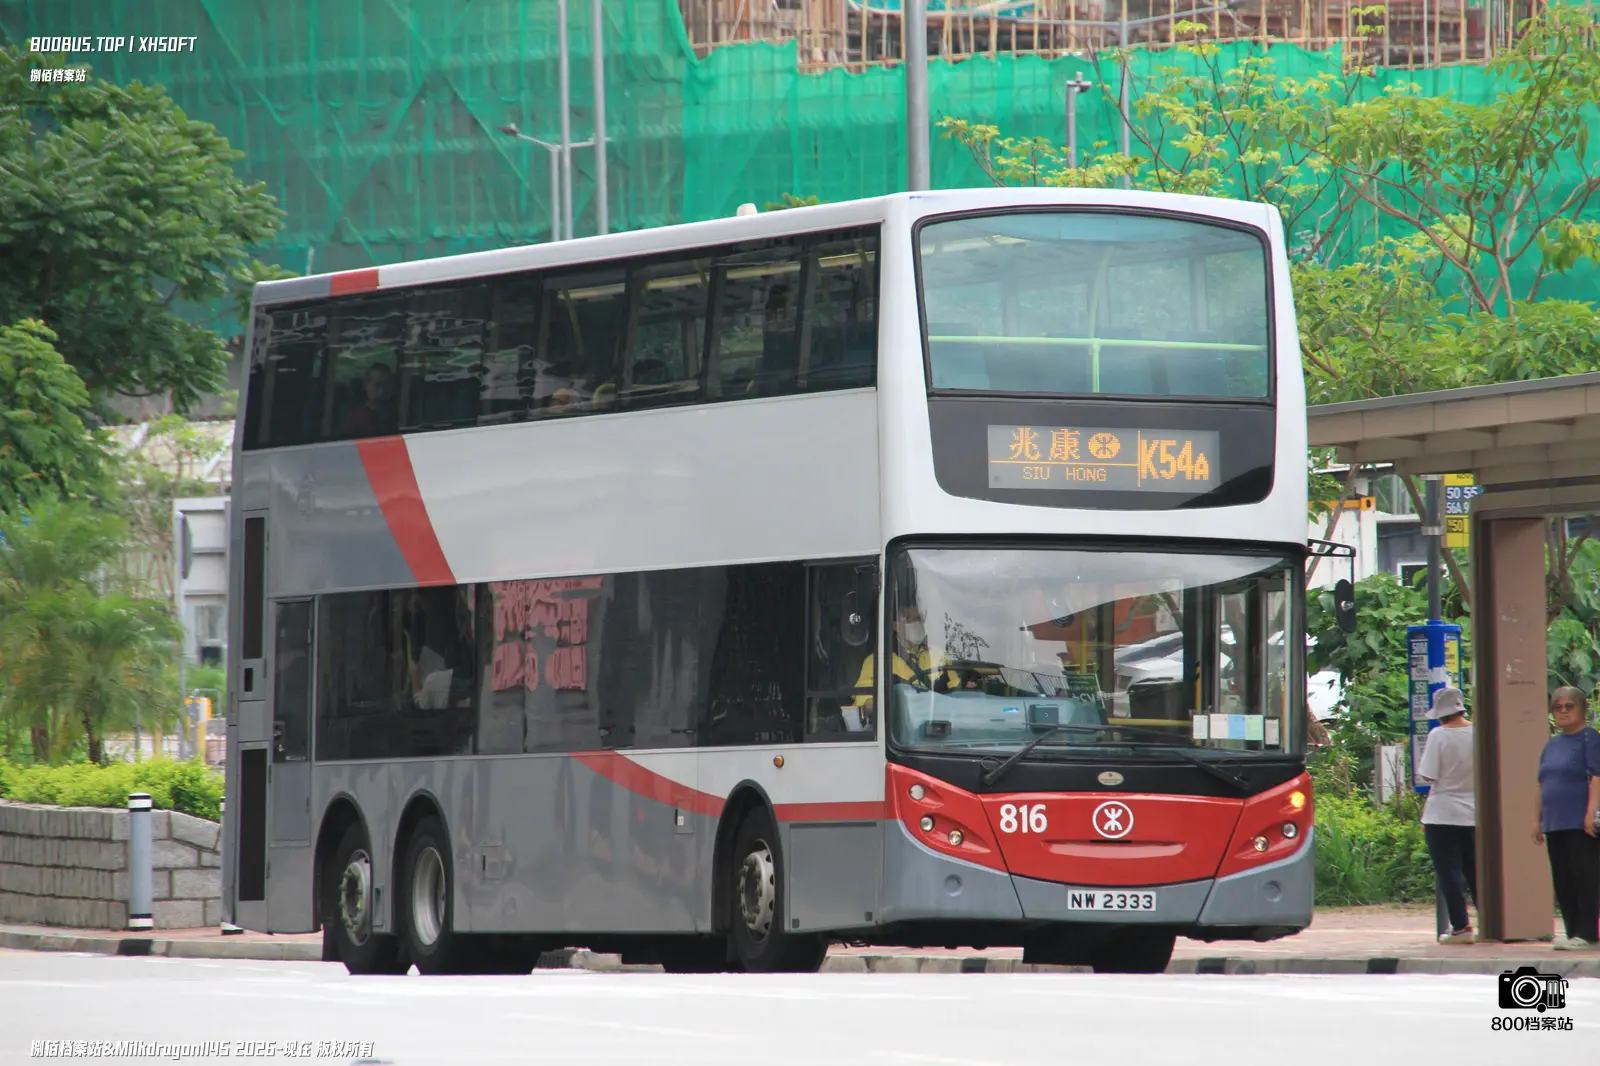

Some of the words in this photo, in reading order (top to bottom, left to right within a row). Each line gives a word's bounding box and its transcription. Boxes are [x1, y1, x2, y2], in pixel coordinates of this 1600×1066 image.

[1009, 428, 1080, 461] 兆康
[1140, 439, 1209, 480] K54A
[1023, 466, 1050, 480] SIU
[1066, 467, 1107, 482] HONG
[1446, 486, 1461, 499] 50
[1446, 501, 1462, 514] 56A
[1000, 803, 1047, 834] 816
[1071, 893, 1095, 908] NW
[1103, 894, 1153, 909] 2333
